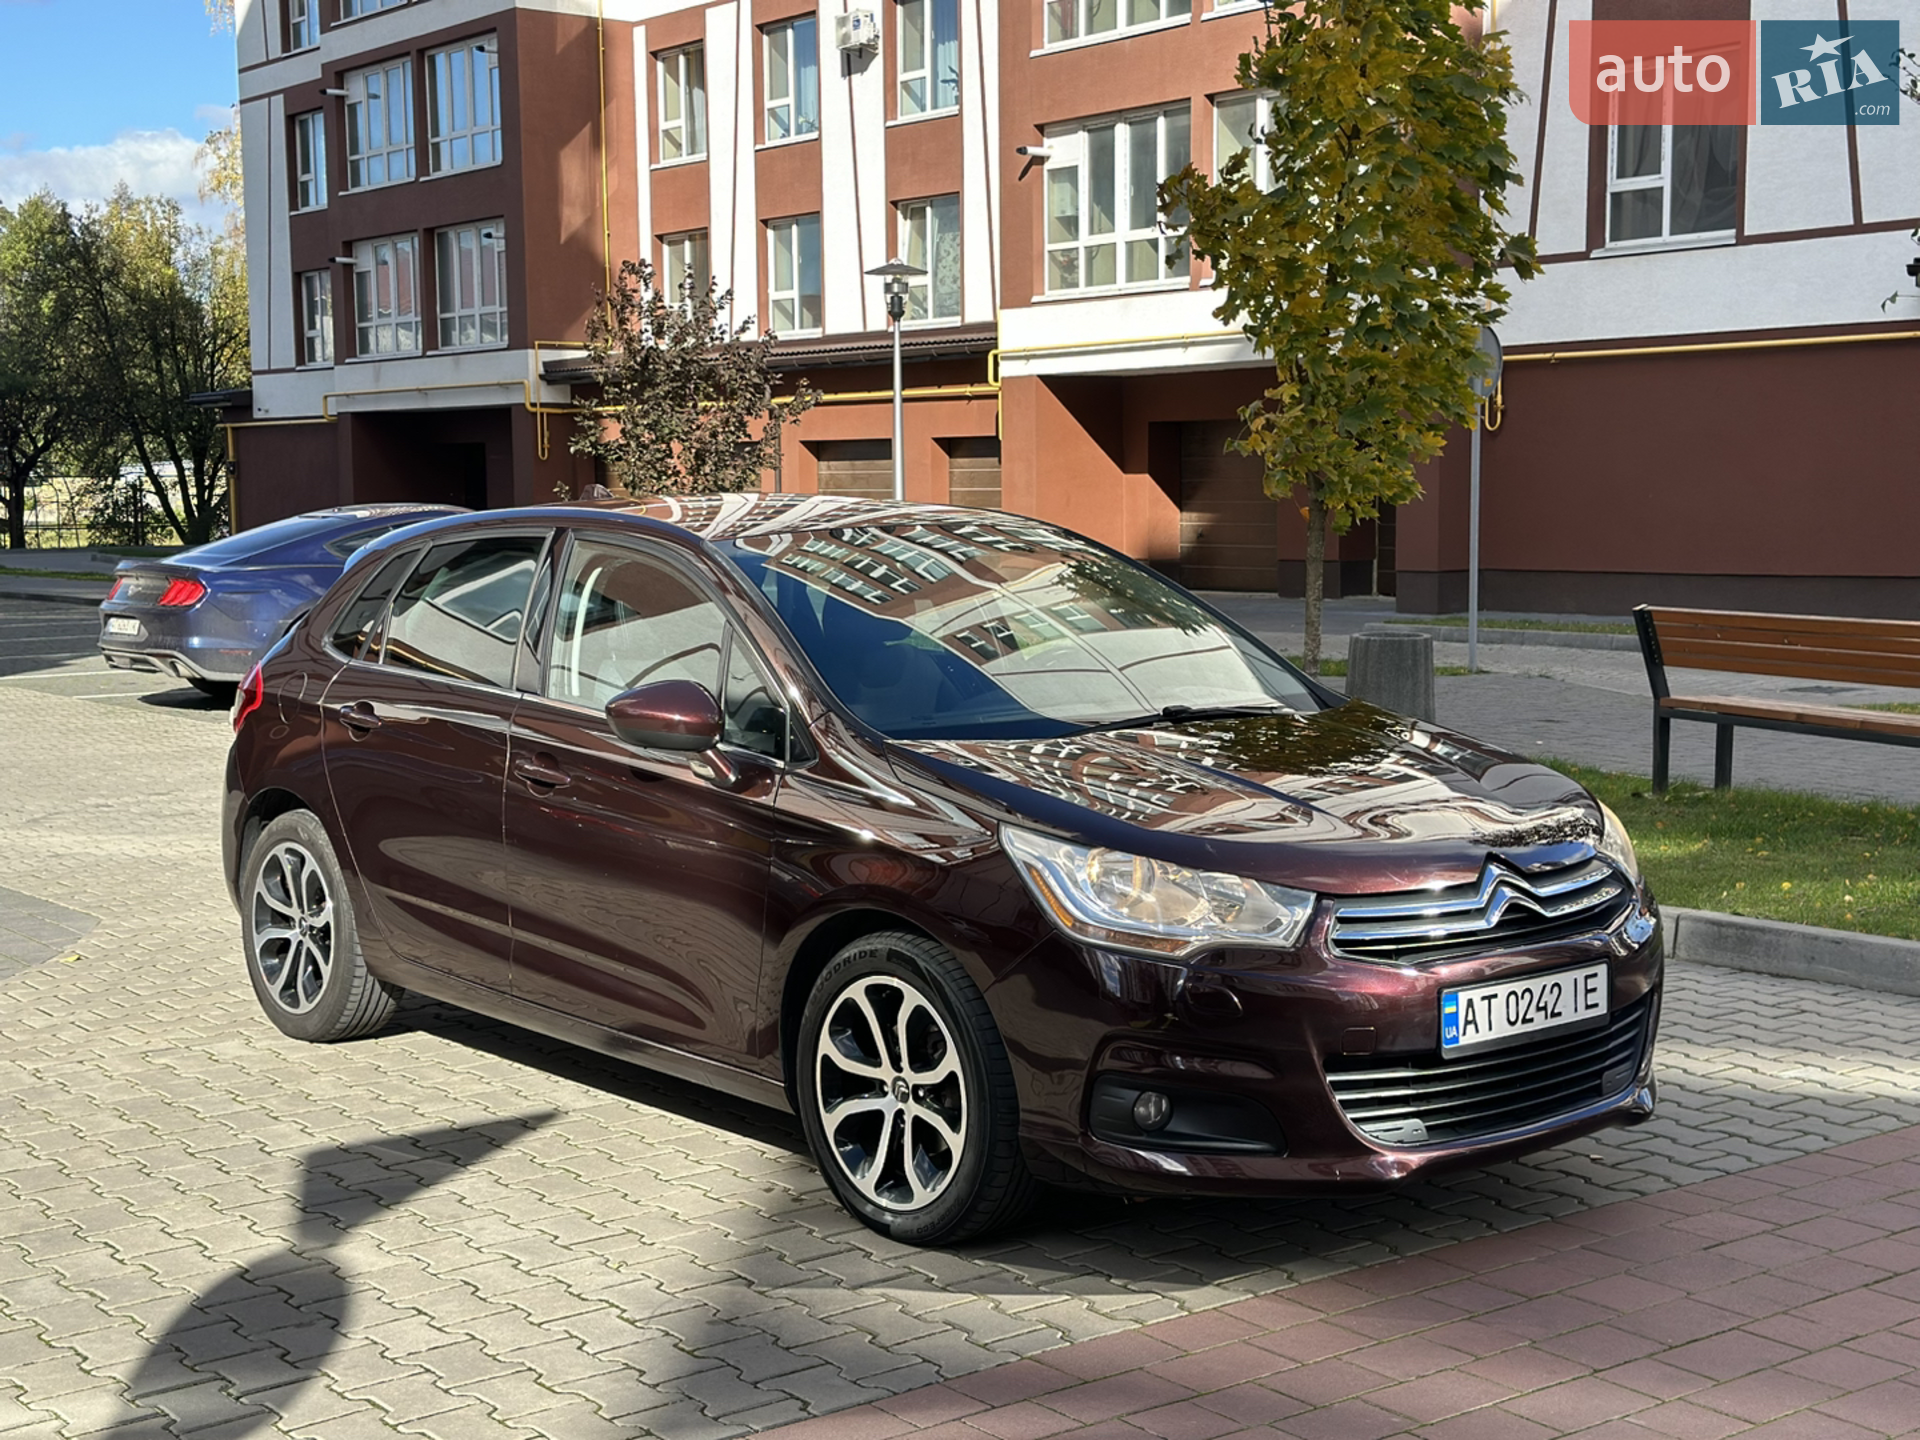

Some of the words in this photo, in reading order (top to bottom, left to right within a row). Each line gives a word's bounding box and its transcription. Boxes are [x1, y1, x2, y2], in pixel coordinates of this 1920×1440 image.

[1462, 993, 1498, 1036] AT
[1505, 982, 1562, 1026] 0242
[1573, 972, 1600, 1013] IE
[1444, 1025, 1458, 1039] UA
